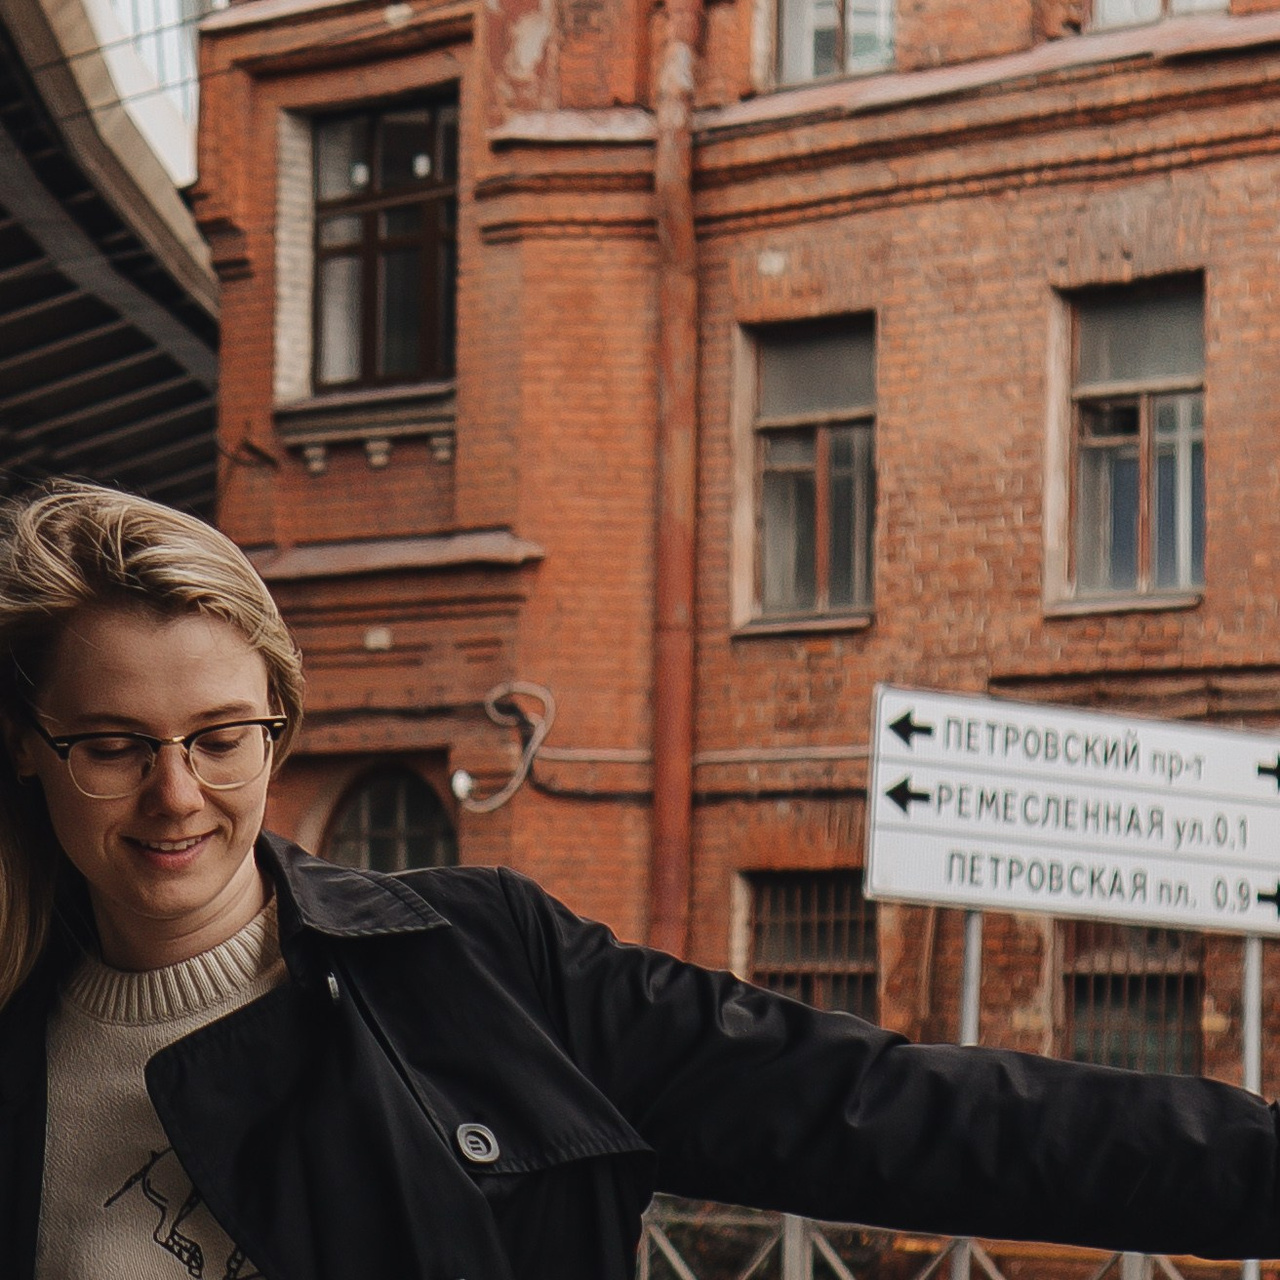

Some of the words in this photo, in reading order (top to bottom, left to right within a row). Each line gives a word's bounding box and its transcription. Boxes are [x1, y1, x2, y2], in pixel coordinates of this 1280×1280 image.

[945, 716, 1140, 772] ПЕТРОВСКИЙ
[1152, 749, 1204, 784] пр-т
[936, 783, 1164, 840] РЕМЕСЛЕННАЯ
[948, 852, 1148, 903] ПЕТРОВСКАЯ
